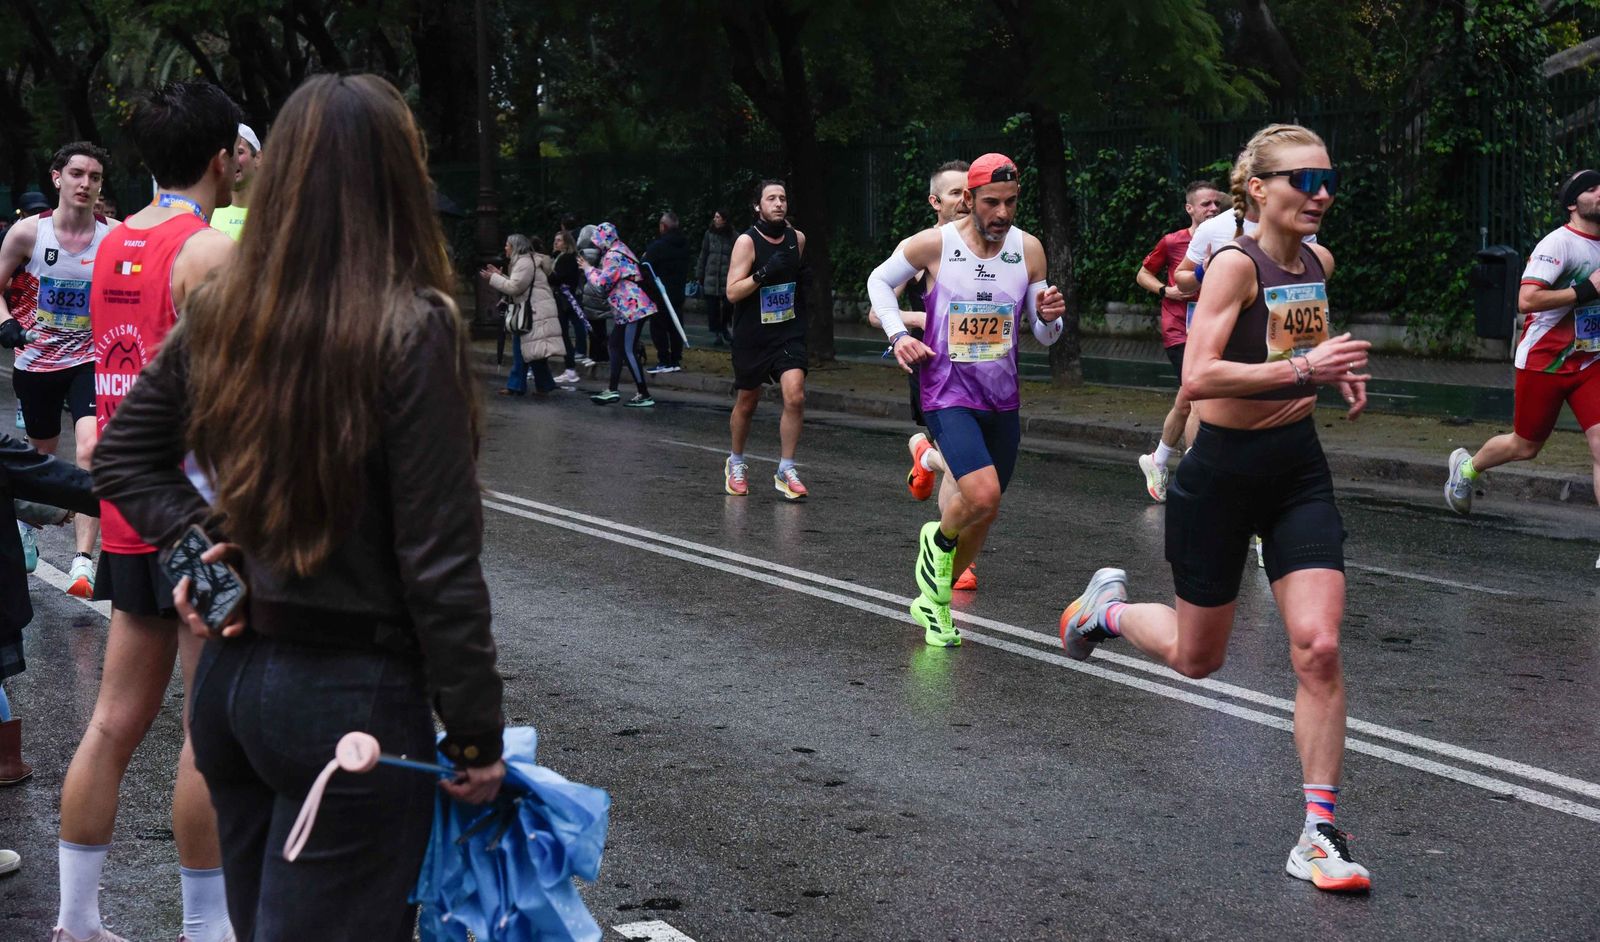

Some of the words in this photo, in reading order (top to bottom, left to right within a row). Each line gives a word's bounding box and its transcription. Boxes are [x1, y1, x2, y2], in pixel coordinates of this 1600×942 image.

[46, 289, 86, 308] 3823
[766, 292, 790, 308] 3465
[958, 316, 998, 336] 4372
[1283, 306, 1323, 335] 4925
